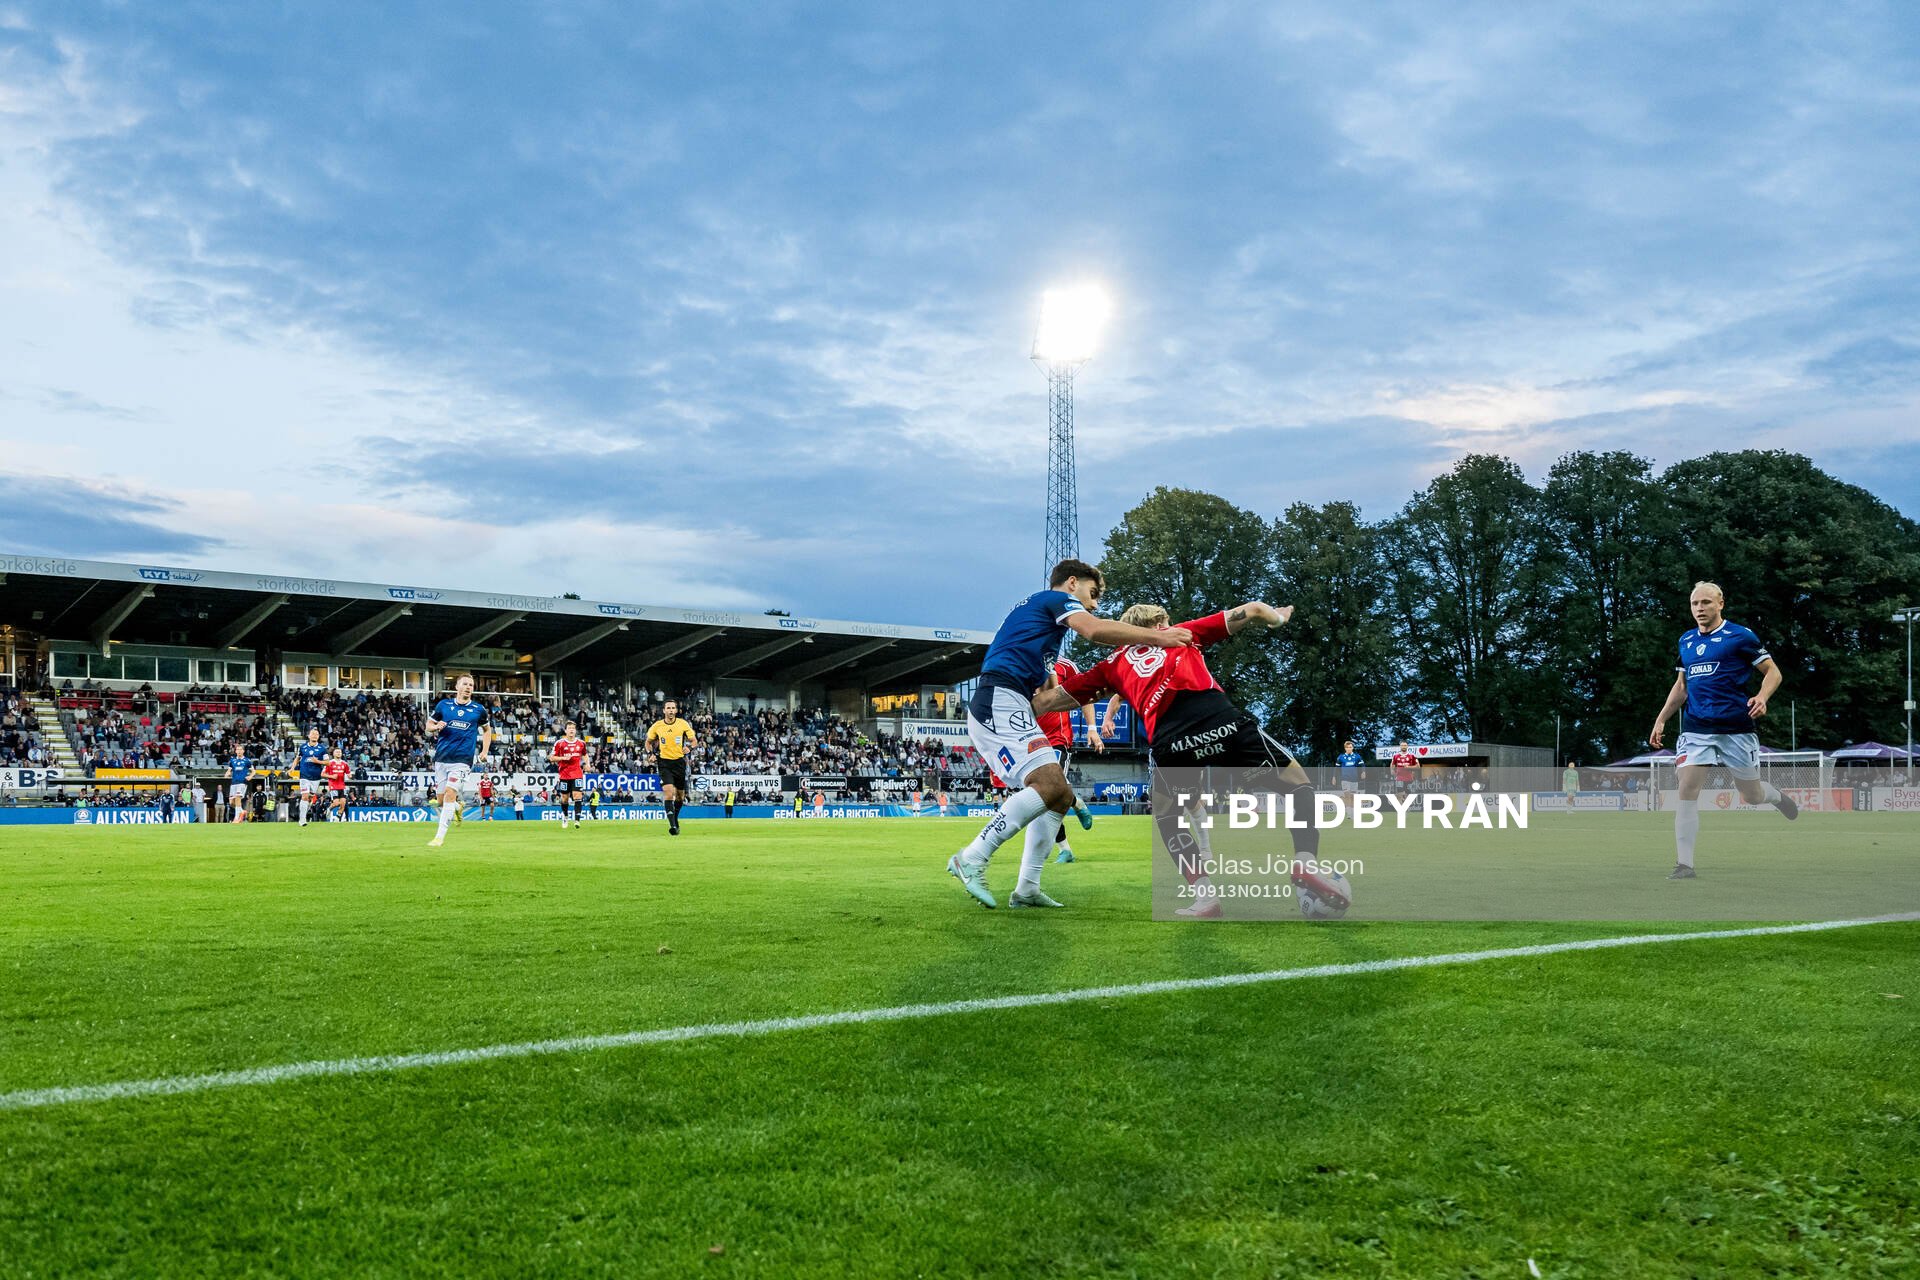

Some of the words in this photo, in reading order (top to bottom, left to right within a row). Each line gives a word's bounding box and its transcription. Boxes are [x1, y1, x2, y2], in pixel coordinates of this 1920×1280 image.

[143, 570, 169, 580] KYL
[392, 590, 414, 599] KYL
[600, 605, 621, 614] KYL
[1124, 645, 1168, 678] 8
[1691, 664, 1713, 675] JONAB
[1170, 722, 1238, 753] MÅNSSON
[1194, 742, 1226, 760] RÖR
[764, 779, 779, 788] VVS
[96, 810, 190, 824] ALLSVENSAN
[612, 807, 627, 820] PÅ
[832, 807, 844, 819] PÅ
